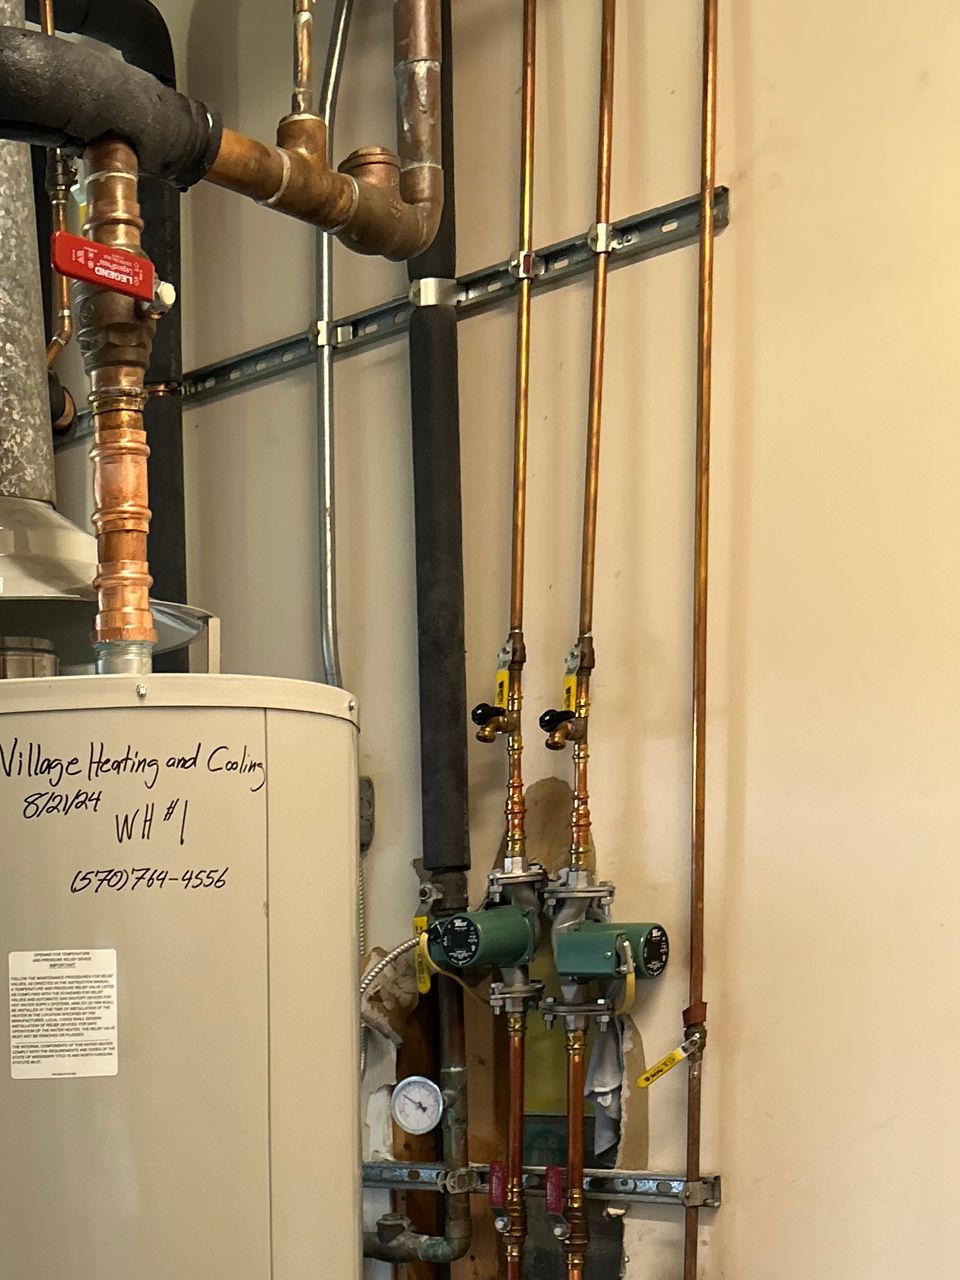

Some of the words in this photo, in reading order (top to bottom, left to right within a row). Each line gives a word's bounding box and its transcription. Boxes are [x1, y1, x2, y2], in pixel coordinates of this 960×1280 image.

[88, 742, 160, 788] Heating
[166, 742, 201, 768] and
[207, 745, 266, 792] Cooling
[23, 789, 103, 819] 8/21/24
[115, 802, 154, 843] WH
[70, 867, 229, 893] (570)764-4556
